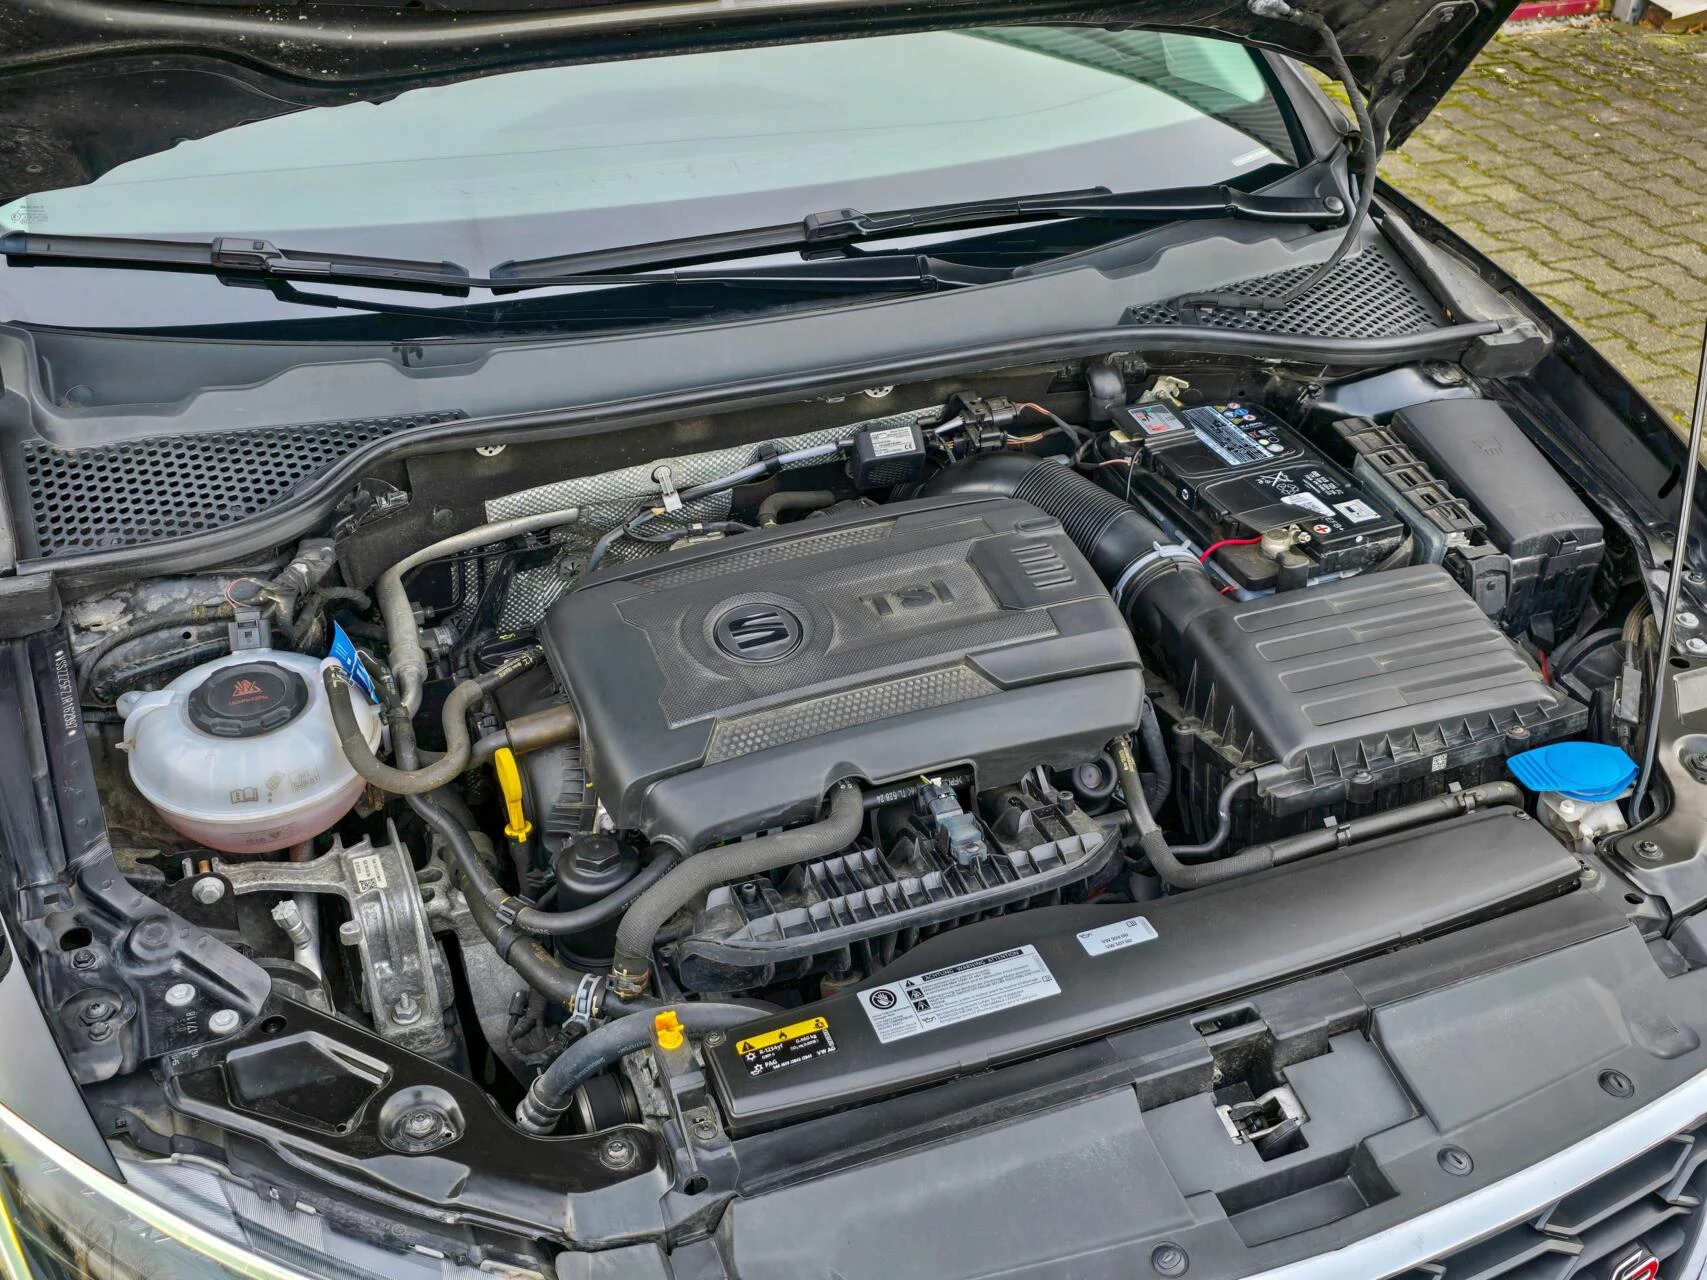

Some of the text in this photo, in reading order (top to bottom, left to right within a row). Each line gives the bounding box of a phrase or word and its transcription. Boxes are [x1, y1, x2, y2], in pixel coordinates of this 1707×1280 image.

[858, 580, 955, 616] TSI
[925, 951, 1019, 981] ACHTUNG WARNING ATTENTION
[764, 1059, 778, 1067] PAG
